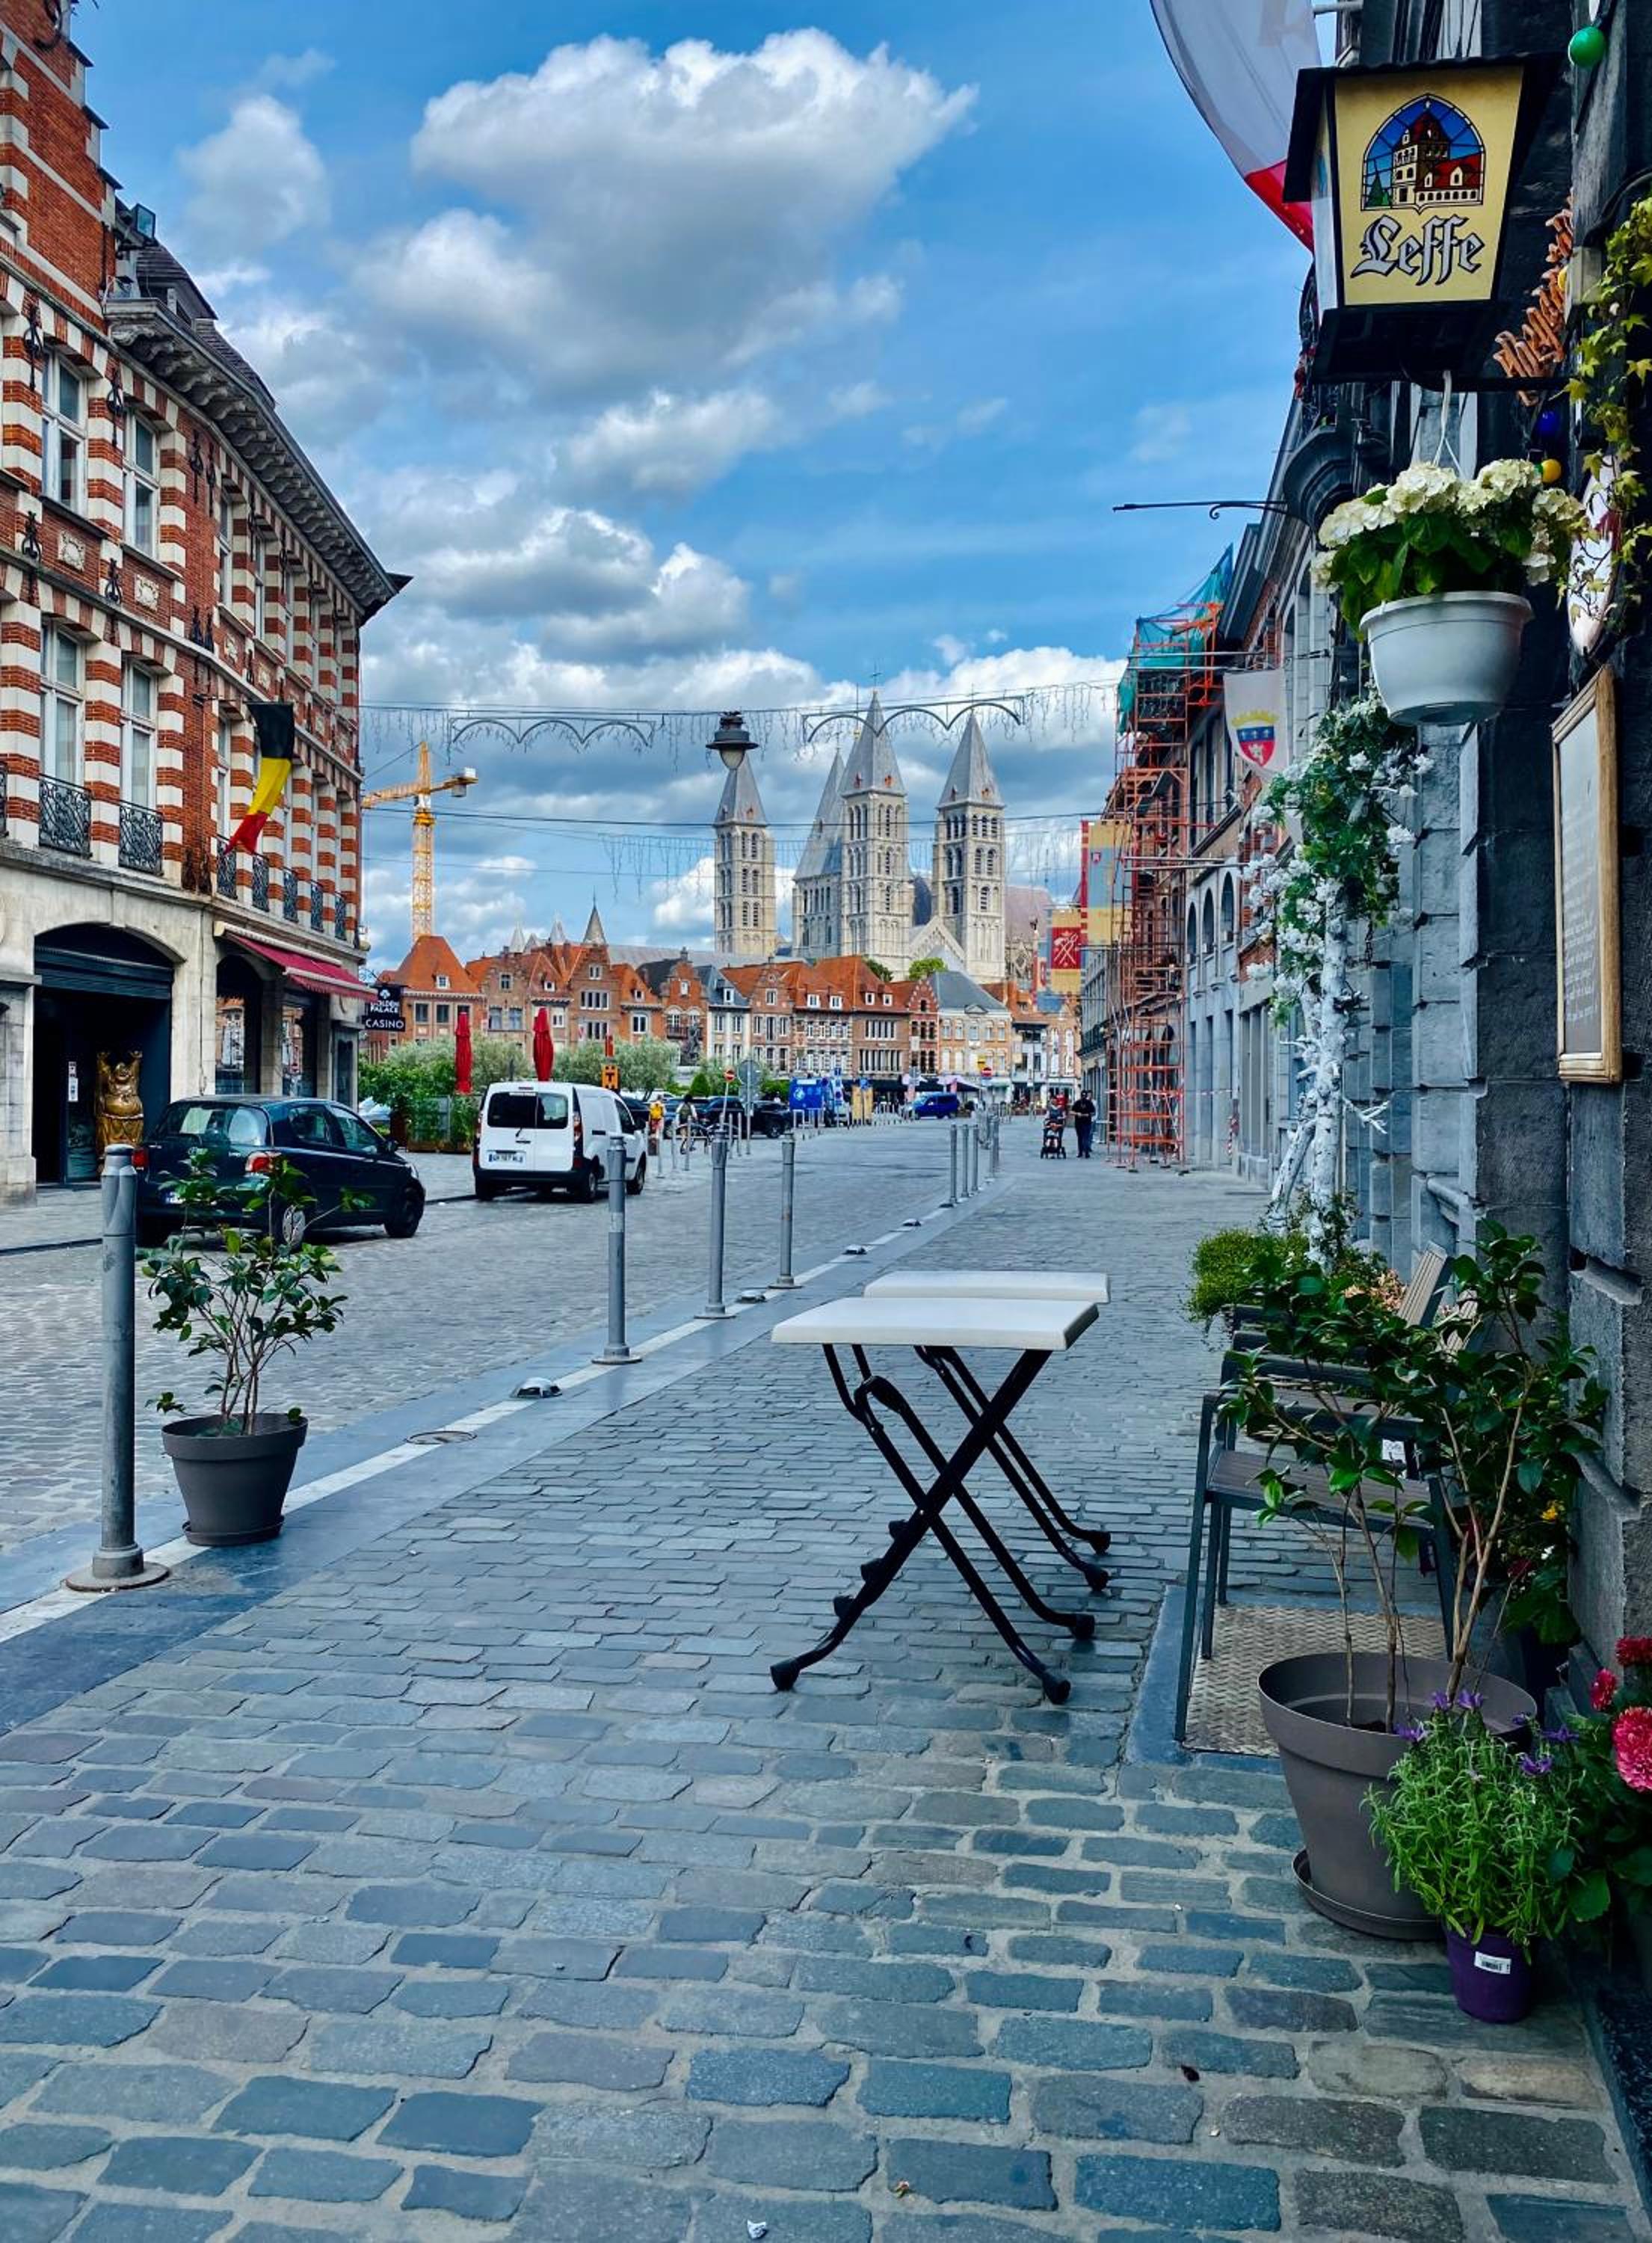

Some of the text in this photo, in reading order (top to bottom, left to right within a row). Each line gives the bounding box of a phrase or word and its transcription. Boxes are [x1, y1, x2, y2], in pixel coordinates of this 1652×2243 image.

[1350, 214, 1485, 286] Leffe
[370, 1005, 398, 1013] PALACE
[366, 1018, 404, 1030] CASINO
